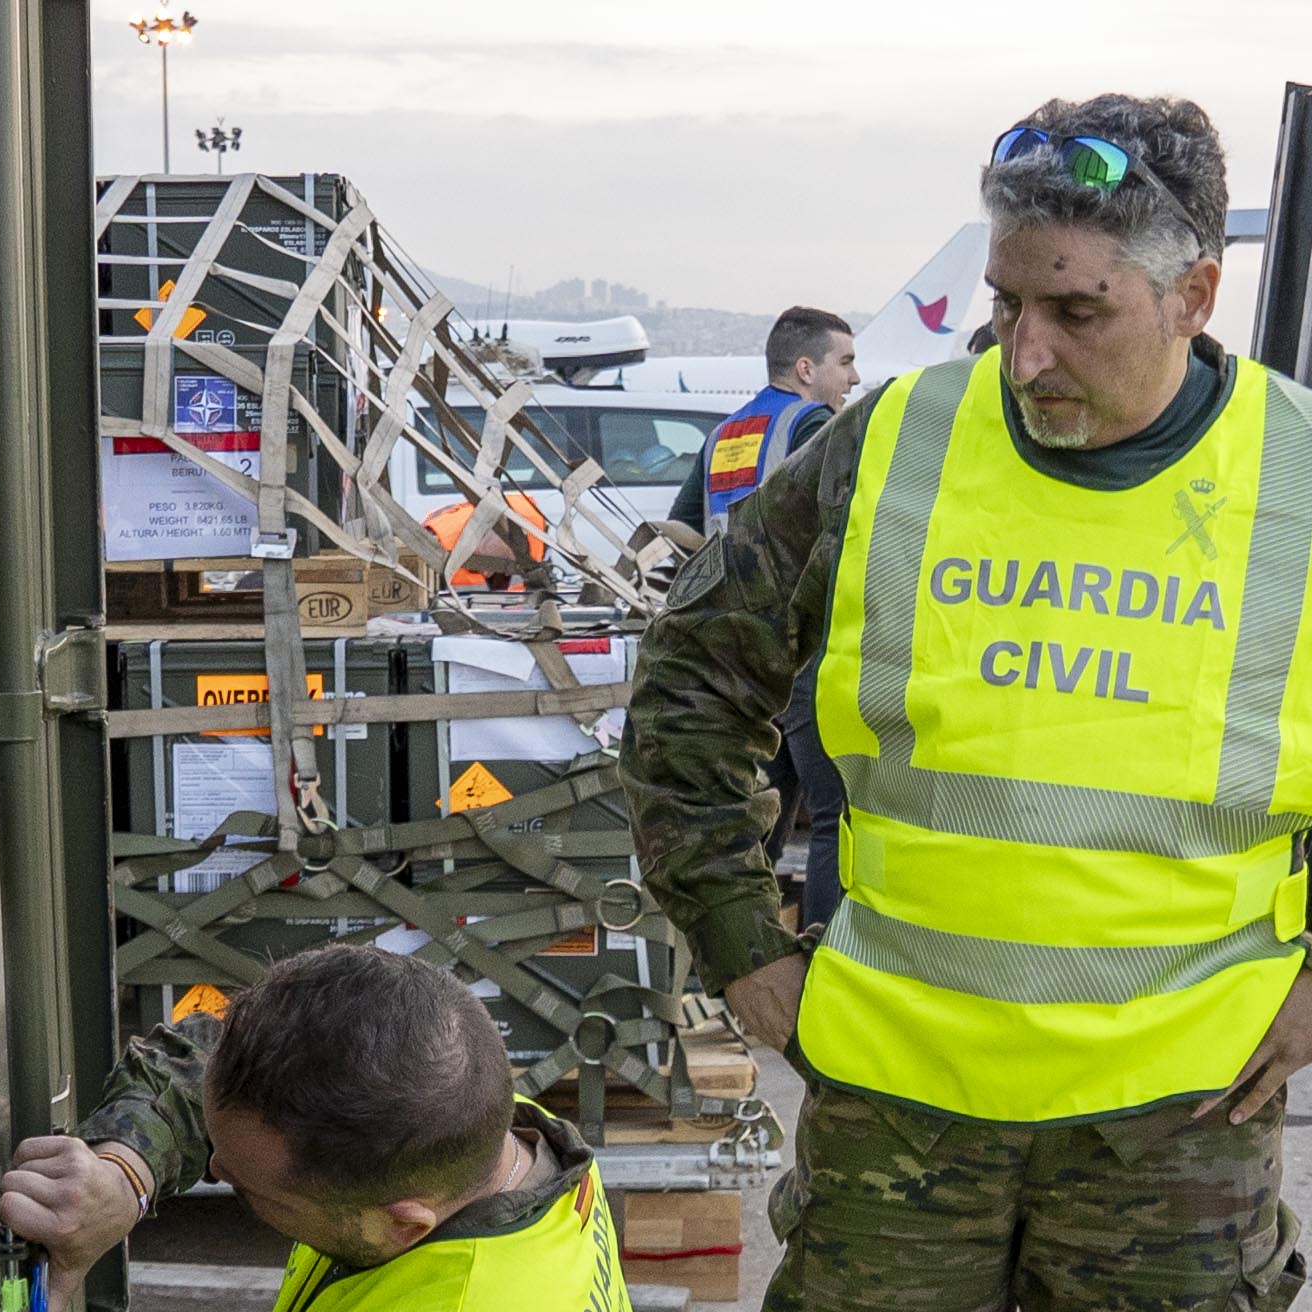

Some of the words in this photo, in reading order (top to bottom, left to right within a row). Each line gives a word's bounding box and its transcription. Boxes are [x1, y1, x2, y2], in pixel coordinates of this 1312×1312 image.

[239, 458, 253, 478] 2
[148, 502, 177, 512] PESO
[148, 515, 189, 525] WEIGHT
[235, 515, 248, 524] LB
[119, 529, 159, 538] ALTURA
[166, 528, 205, 538] HEIGHT
[371, 580, 402, 599] EUR
[930, 557, 1227, 632] GUARDIA
[308, 599, 341, 619] EUR
[980, 640, 1150, 705] CIVIL
